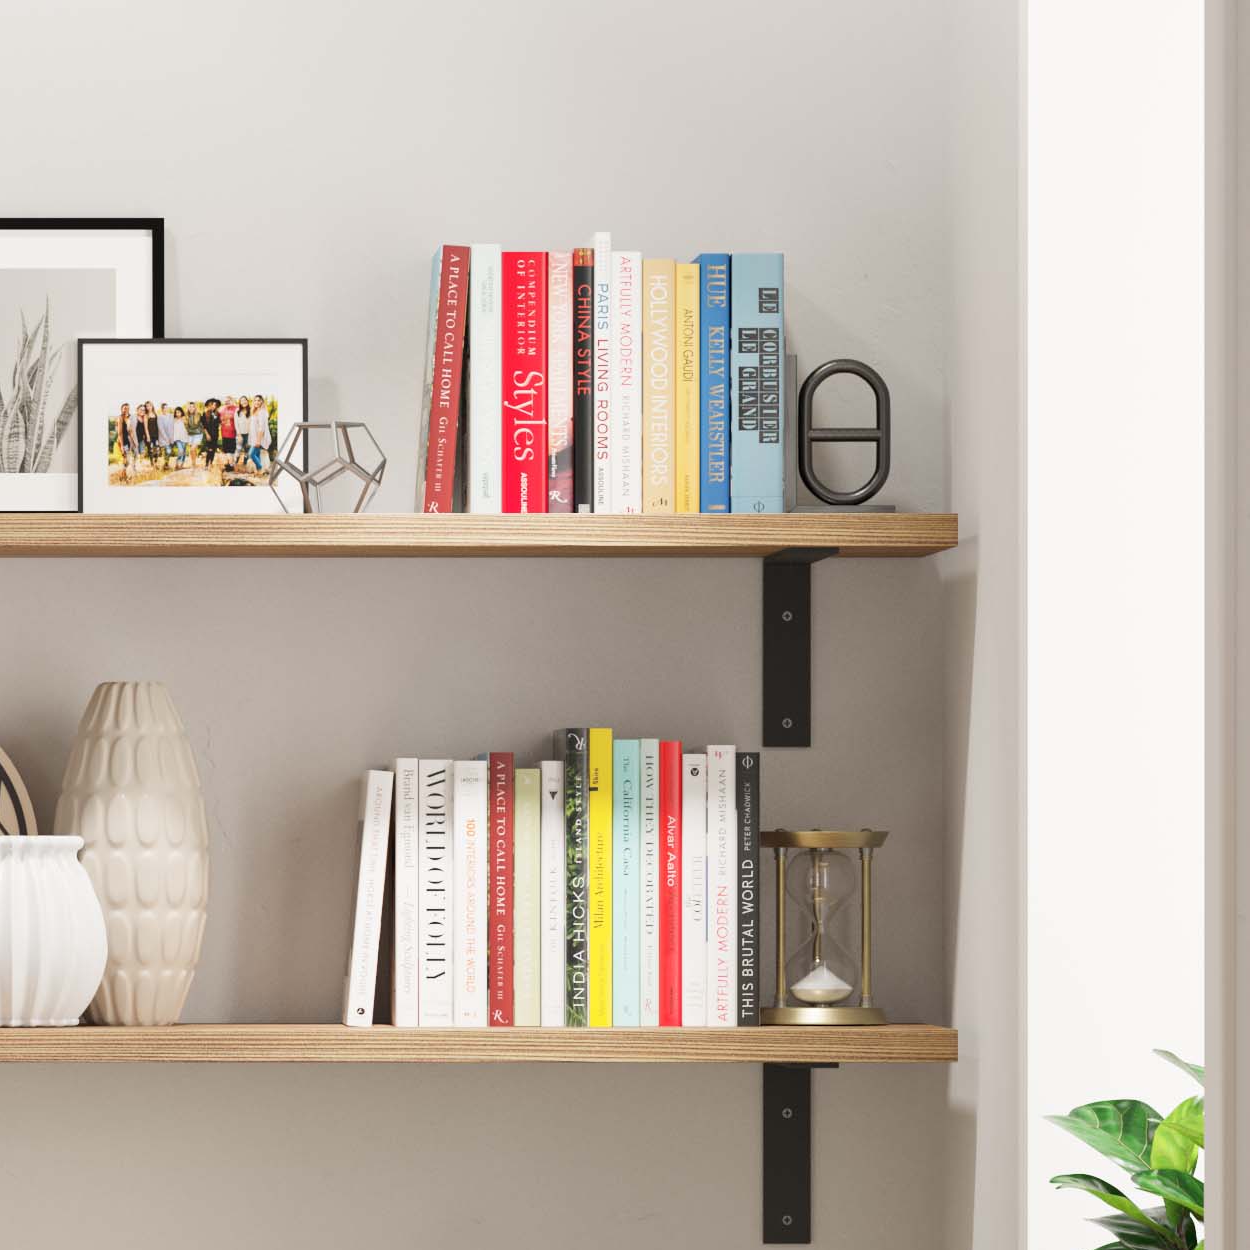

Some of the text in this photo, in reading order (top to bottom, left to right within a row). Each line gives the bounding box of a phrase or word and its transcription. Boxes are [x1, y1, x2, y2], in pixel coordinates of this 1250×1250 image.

[450, 254, 460, 262] A
[552, 262, 568, 296] NEW
[447, 266, 460, 306] PLACE
[517, 260, 526, 354] OF INTERIOR
[527, 259, 536, 356] COMPENDIUM
[598, 284, 608, 330] PARIS
[707, 264, 726, 308] HUE
[446, 310, 456, 328] TO
[577, 284, 590, 396] CHINA STYLE
[620, 256, 632, 386] ARTFULLY MODERN
[683, 308, 694, 347] ANTONI
[442, 332, 454, 365] CALL
[598, 339, 608, 392] LIVING
[683, 350, 694, 382] GAUDI
[760, 288, 778, 444] LE CORBUSIER
[440, 368, 452, 408] HOME
[650, 274, 666, 484] HOLLYWOOD INTERIORS
[739, 328, 758, 430] LE GRAND
[503, 370, 546, 461] Styles
[708, 325, 724, 482] KELLY WEARSTLER
[598, 400, 608, 460] ROOMS
[622, 396, 630, 496] RICHARD MISHAAN
[404, 768, 414, 800] Brand
[496, 761, 506, 770] A
[646, 755, 654, 790] HOW
[496, 774, 506, 813] PLACE
[622, 779, 633, 842] California
[466, 818, 476, 837] 100
[496, 816, 506, 836] TO
[646, 797, 654, 835] THEY
[667, 815, 676, 848] Alvar
[718, 770, 726, 876] RICHARD MISHAAN
[426, 769, 446, 980] WORLD OF FOLLY
[496, 840, 506, 872] CALL
[622, 847, 632, 876] Casa
[667, 852, 676, 886] Aalto
[496, 876, 506, 916] HOME
[646, 842, 654, 935] DECORATED
[572, 876, 584, 1008] INDIA HICKS
[718, 886, 728, 1022] ARTFULLY MODERN
[741, 860, 754, 1018] THIS BRUTAL WORLD
